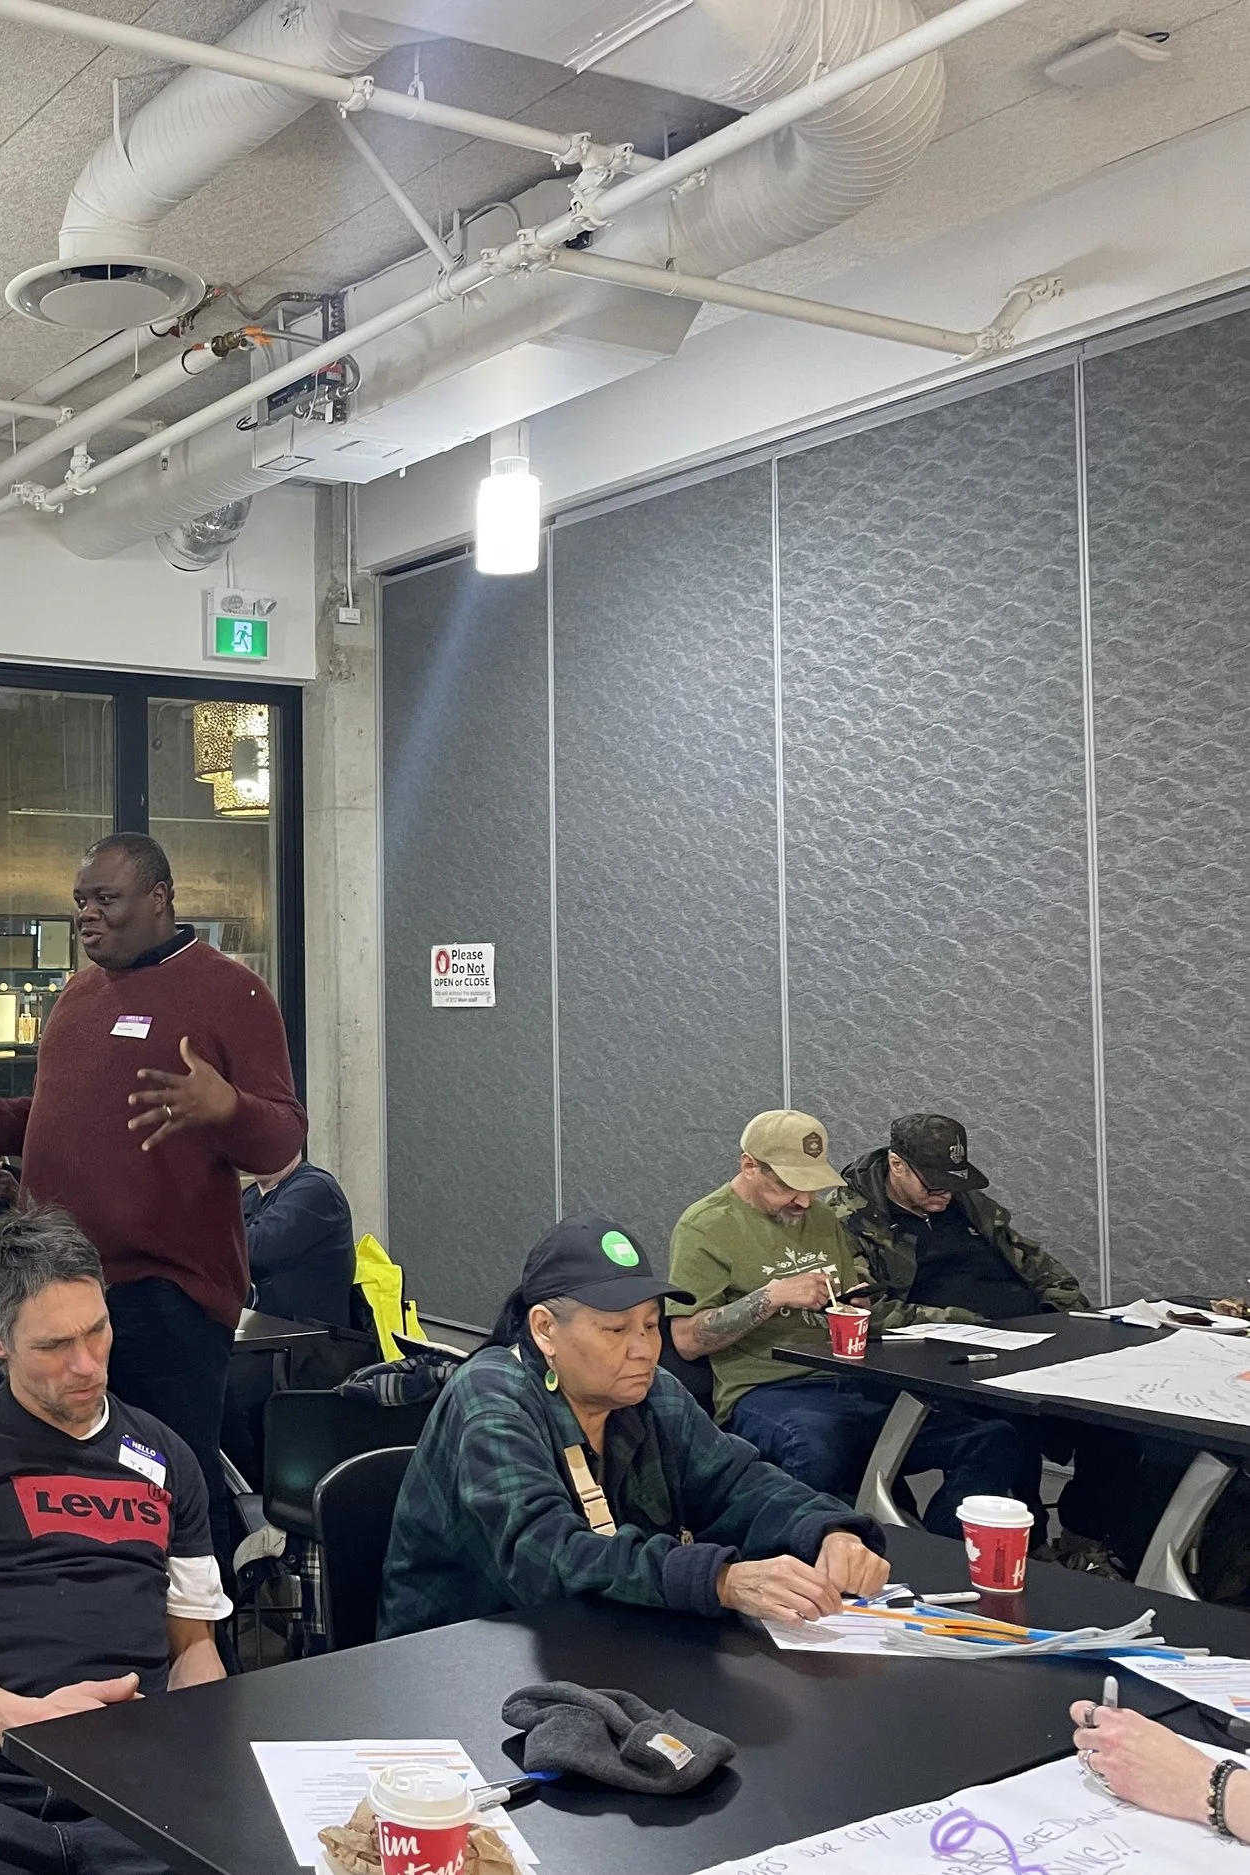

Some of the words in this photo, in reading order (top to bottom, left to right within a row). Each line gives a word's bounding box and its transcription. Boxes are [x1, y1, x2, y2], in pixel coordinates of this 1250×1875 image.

[451, 949, 483, 960] Please
[452, 963, 465, 974] Do
[467, 963, 485, 974] Not
[434, 978, 453, 987] OPEN
[455, 979, 463, 987] or
[464, 978, 490, 987] CLOSE
[132, 1441, 157, 1457] HELLO
[845, 1823, 891, 1843] CITY
